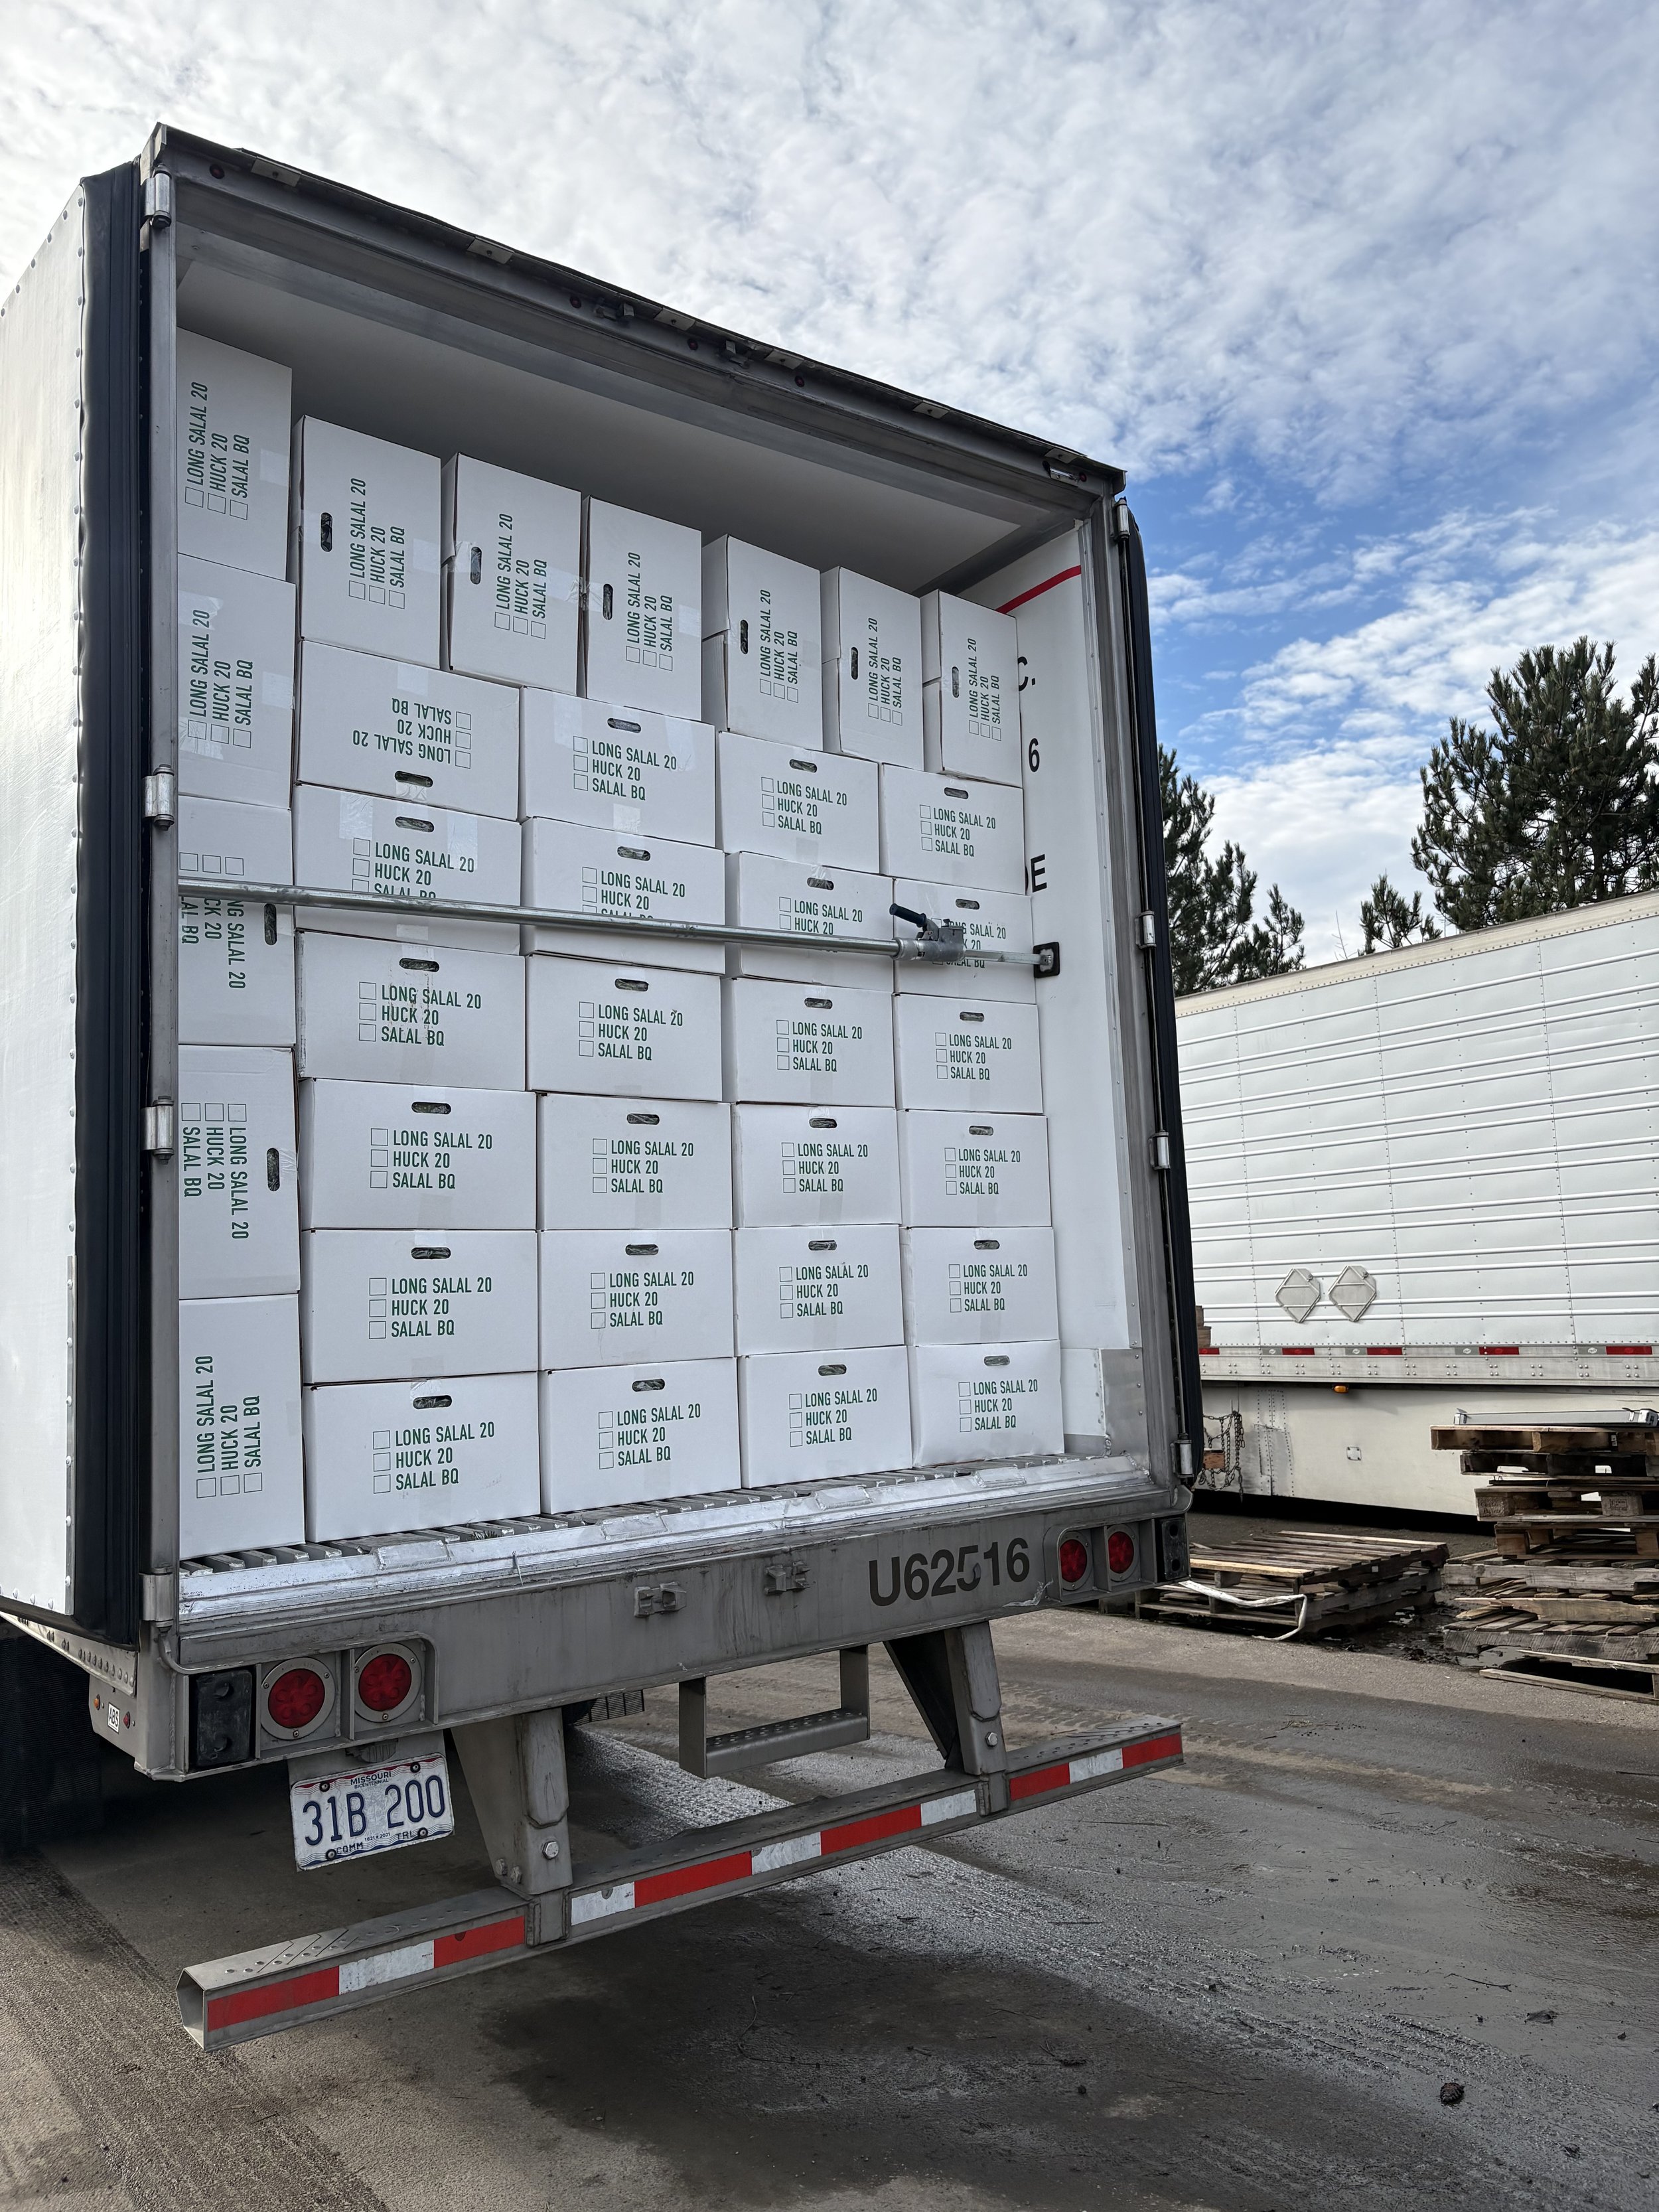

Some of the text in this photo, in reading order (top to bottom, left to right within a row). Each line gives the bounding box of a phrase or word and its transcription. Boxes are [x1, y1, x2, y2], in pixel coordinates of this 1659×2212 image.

[186, 381, 208, 486] LONG SALAL 20
[209, 433, 228, 492] HUCK 20
[231, 434, 250, 499] SALAL BQ
[349, 477, 368, 579] LONG SALAL 20
[370, 526, 387, 584] HUCK 20
[389, 526, 405, 589] SALAL BQ
[759, 589, 772, 677] LONG SALAL 20
[188, 609, 210, 717] LONG SALAL 20
[772, 630, 785, 682] HUCK 20
[786, 630, 798, 685] SALAL BQ
[212, 660, 232, 722] HUCK 20
[967, 638, 979, 719] LONG SALAL 20
[234, 659, 253, 726] SALAL BQ
[979, 676, 990, 721] HUCK 20
[990, 675, 1001, 725] SALAL BQ
[391, 697, 452, 725] SALAL BQ
[397, 719, 451, 745] HUCK 20
[352, 729, 451, 765] LONG SALAL 20
[592, 740, 677, 771] LONG SALAL 20
[1029, 738, 1040, 773] 6
[592, 759, 641, 782] HUCK 20
[592, 777, 646, 802] SALAL BQ
[933, 807, 996, 830] LONG SALAL 20
[934, 823, 970, 841] HUCK 20
[375, 842, 475, 873] LONG SALAL 20
[935, 839, 975, 857] SALAL BQ
[374, 862, 432, 886] HUCK 20
[1025, 853, 1048, 893] E
[204, 898, 222, 940] CK 20
[181, 925, 199, 944] BQ
[227, 900, 246, 989] NG SALAL 20
[598, 1003, 684, 1027] LONG SALAL 20
[598, 1023, 648, 1042] HUCK 20
[949, 1033, 1012, 1050] LONG SALAL 20
[597, 1042, 652, 1061] SALAL BQ
[950, 1049, 986, 1065] HUCK 20
[950, 1066, 991, 1081] SALAL BQ
[393, 1130, 492, 1150] LONG SALAL 20
[797, 1143, 869, 1158] LONG SALAL 20
[182, 1126, 204, 1198] SALAL BQ
[205, 1127, 227, 1190] HUCK 20
[393, 1150, 451, 1169] HUCK 20
[798, 1160, 839, 1175] HUCK 20
[229, 1127, 250, 1240] LONG SALAL 20
[392, 1171, 456, 1190] SALAL BQ
[798, 1178, 844, 1193] SALAL BQ
[609, 1271, 694, 1288] LONG SALAL 20
[963, 1264, 1028, 1278] LONG SALAL 20
[609, 1291, 658, 1308] HUCK 20
[964, 1281, 1001, 1295] HUCK 20
[964, 1297, 1005, 1312] SALAL BQ
[609, 1310, 664, 1327] SALAL BQ
[973, 1378, 1039, 1396] LONG SALAL 20
[194, 1355, 216, 1473] LONG SALAL 20
[974, 1397, 1013, 1414] HUCK 20
[242, 1395, 261, 1468] SALAL BQ
[395, 1421, 495, 1447] LONG SALAL 20
[974, 1414, 1017, 1431] SALAL BQ
[220, 1404, 239, 1471] HUCK 20
[396, 1447, 453, 1469] HUCK 20
[396, 1467, 459, 1491] SALAL BQ
[869, 1537, 1030, 1607] U62516
[109, 1707, 119, 1728] ABS
[350, 1771, 392, 1785] MISSOURI
[354, 1779, 389, 1789] BICENTENNIAL
[303, 1775, 445, 1846] 31B 200
[336, 1842, 363, 1854] COMM
